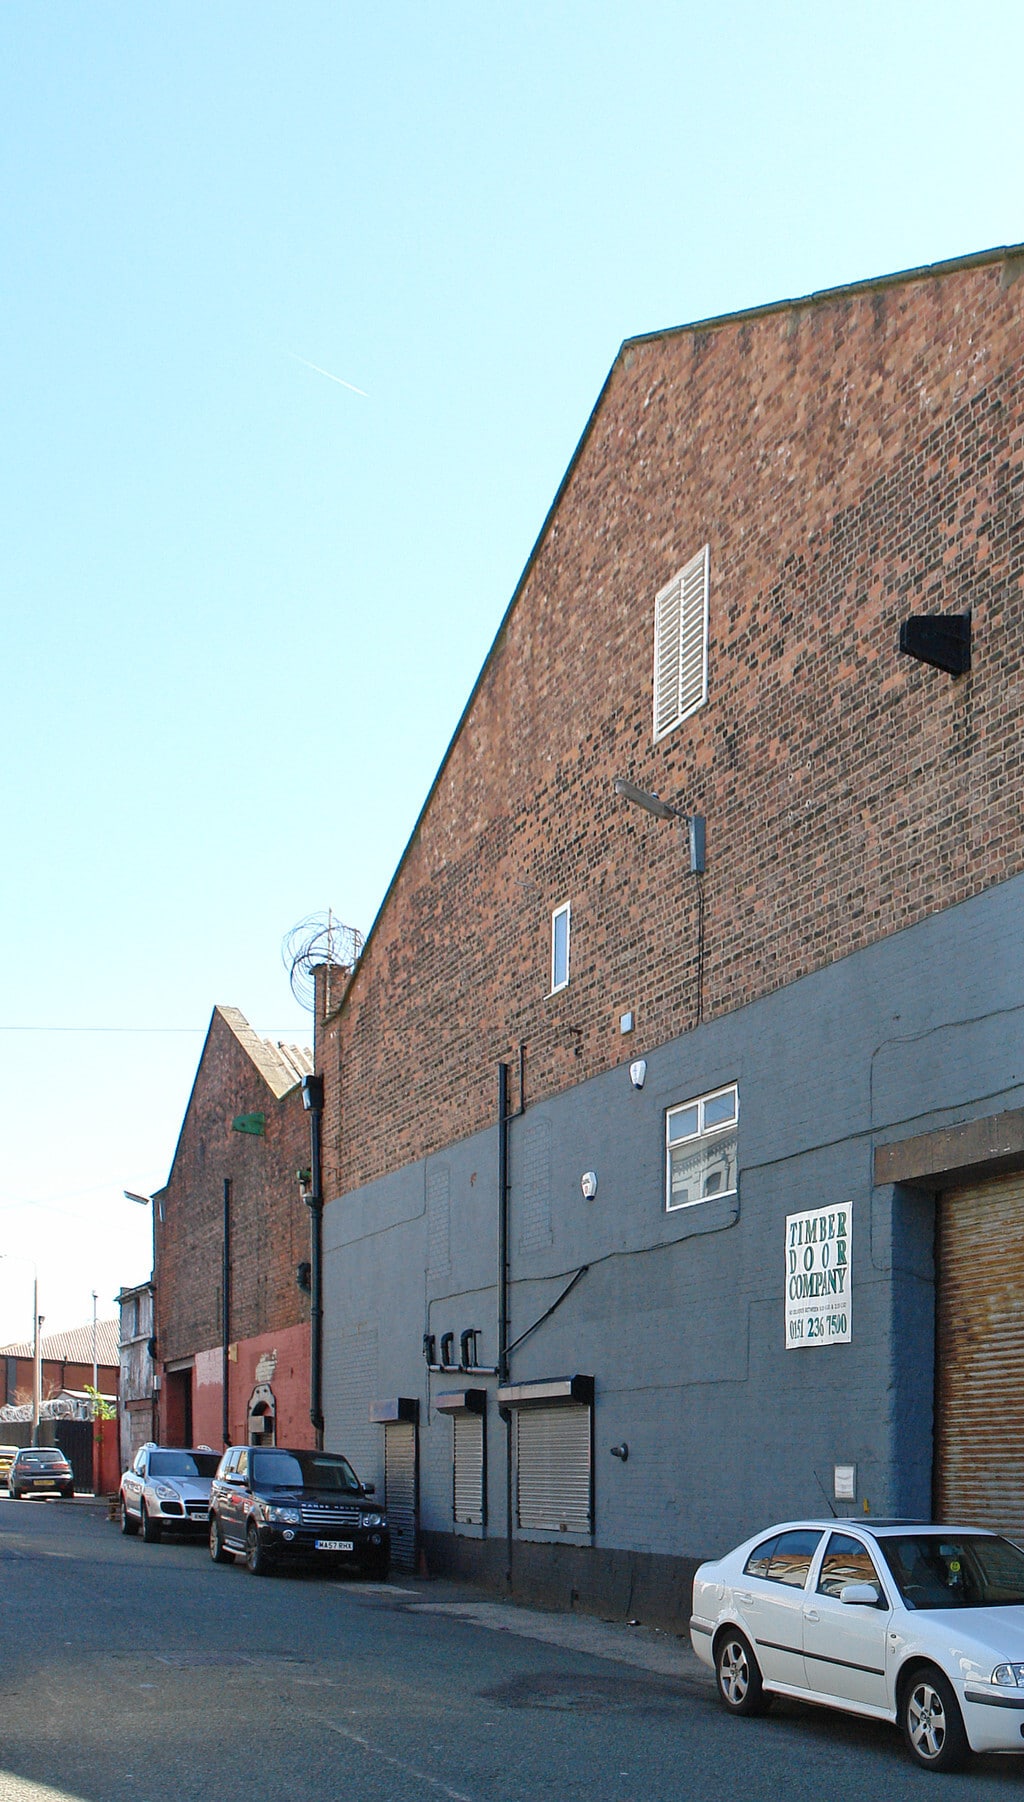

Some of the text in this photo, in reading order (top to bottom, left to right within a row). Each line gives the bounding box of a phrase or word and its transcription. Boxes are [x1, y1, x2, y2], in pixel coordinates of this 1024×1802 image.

[789, 1211, 848, 1248] TIMBER
[789, 1239, 848, 1275] DOOR
[789, 1267, 848, 1301] COMPANY
[789, 1313, 848, 1340] 0151 236 7500
